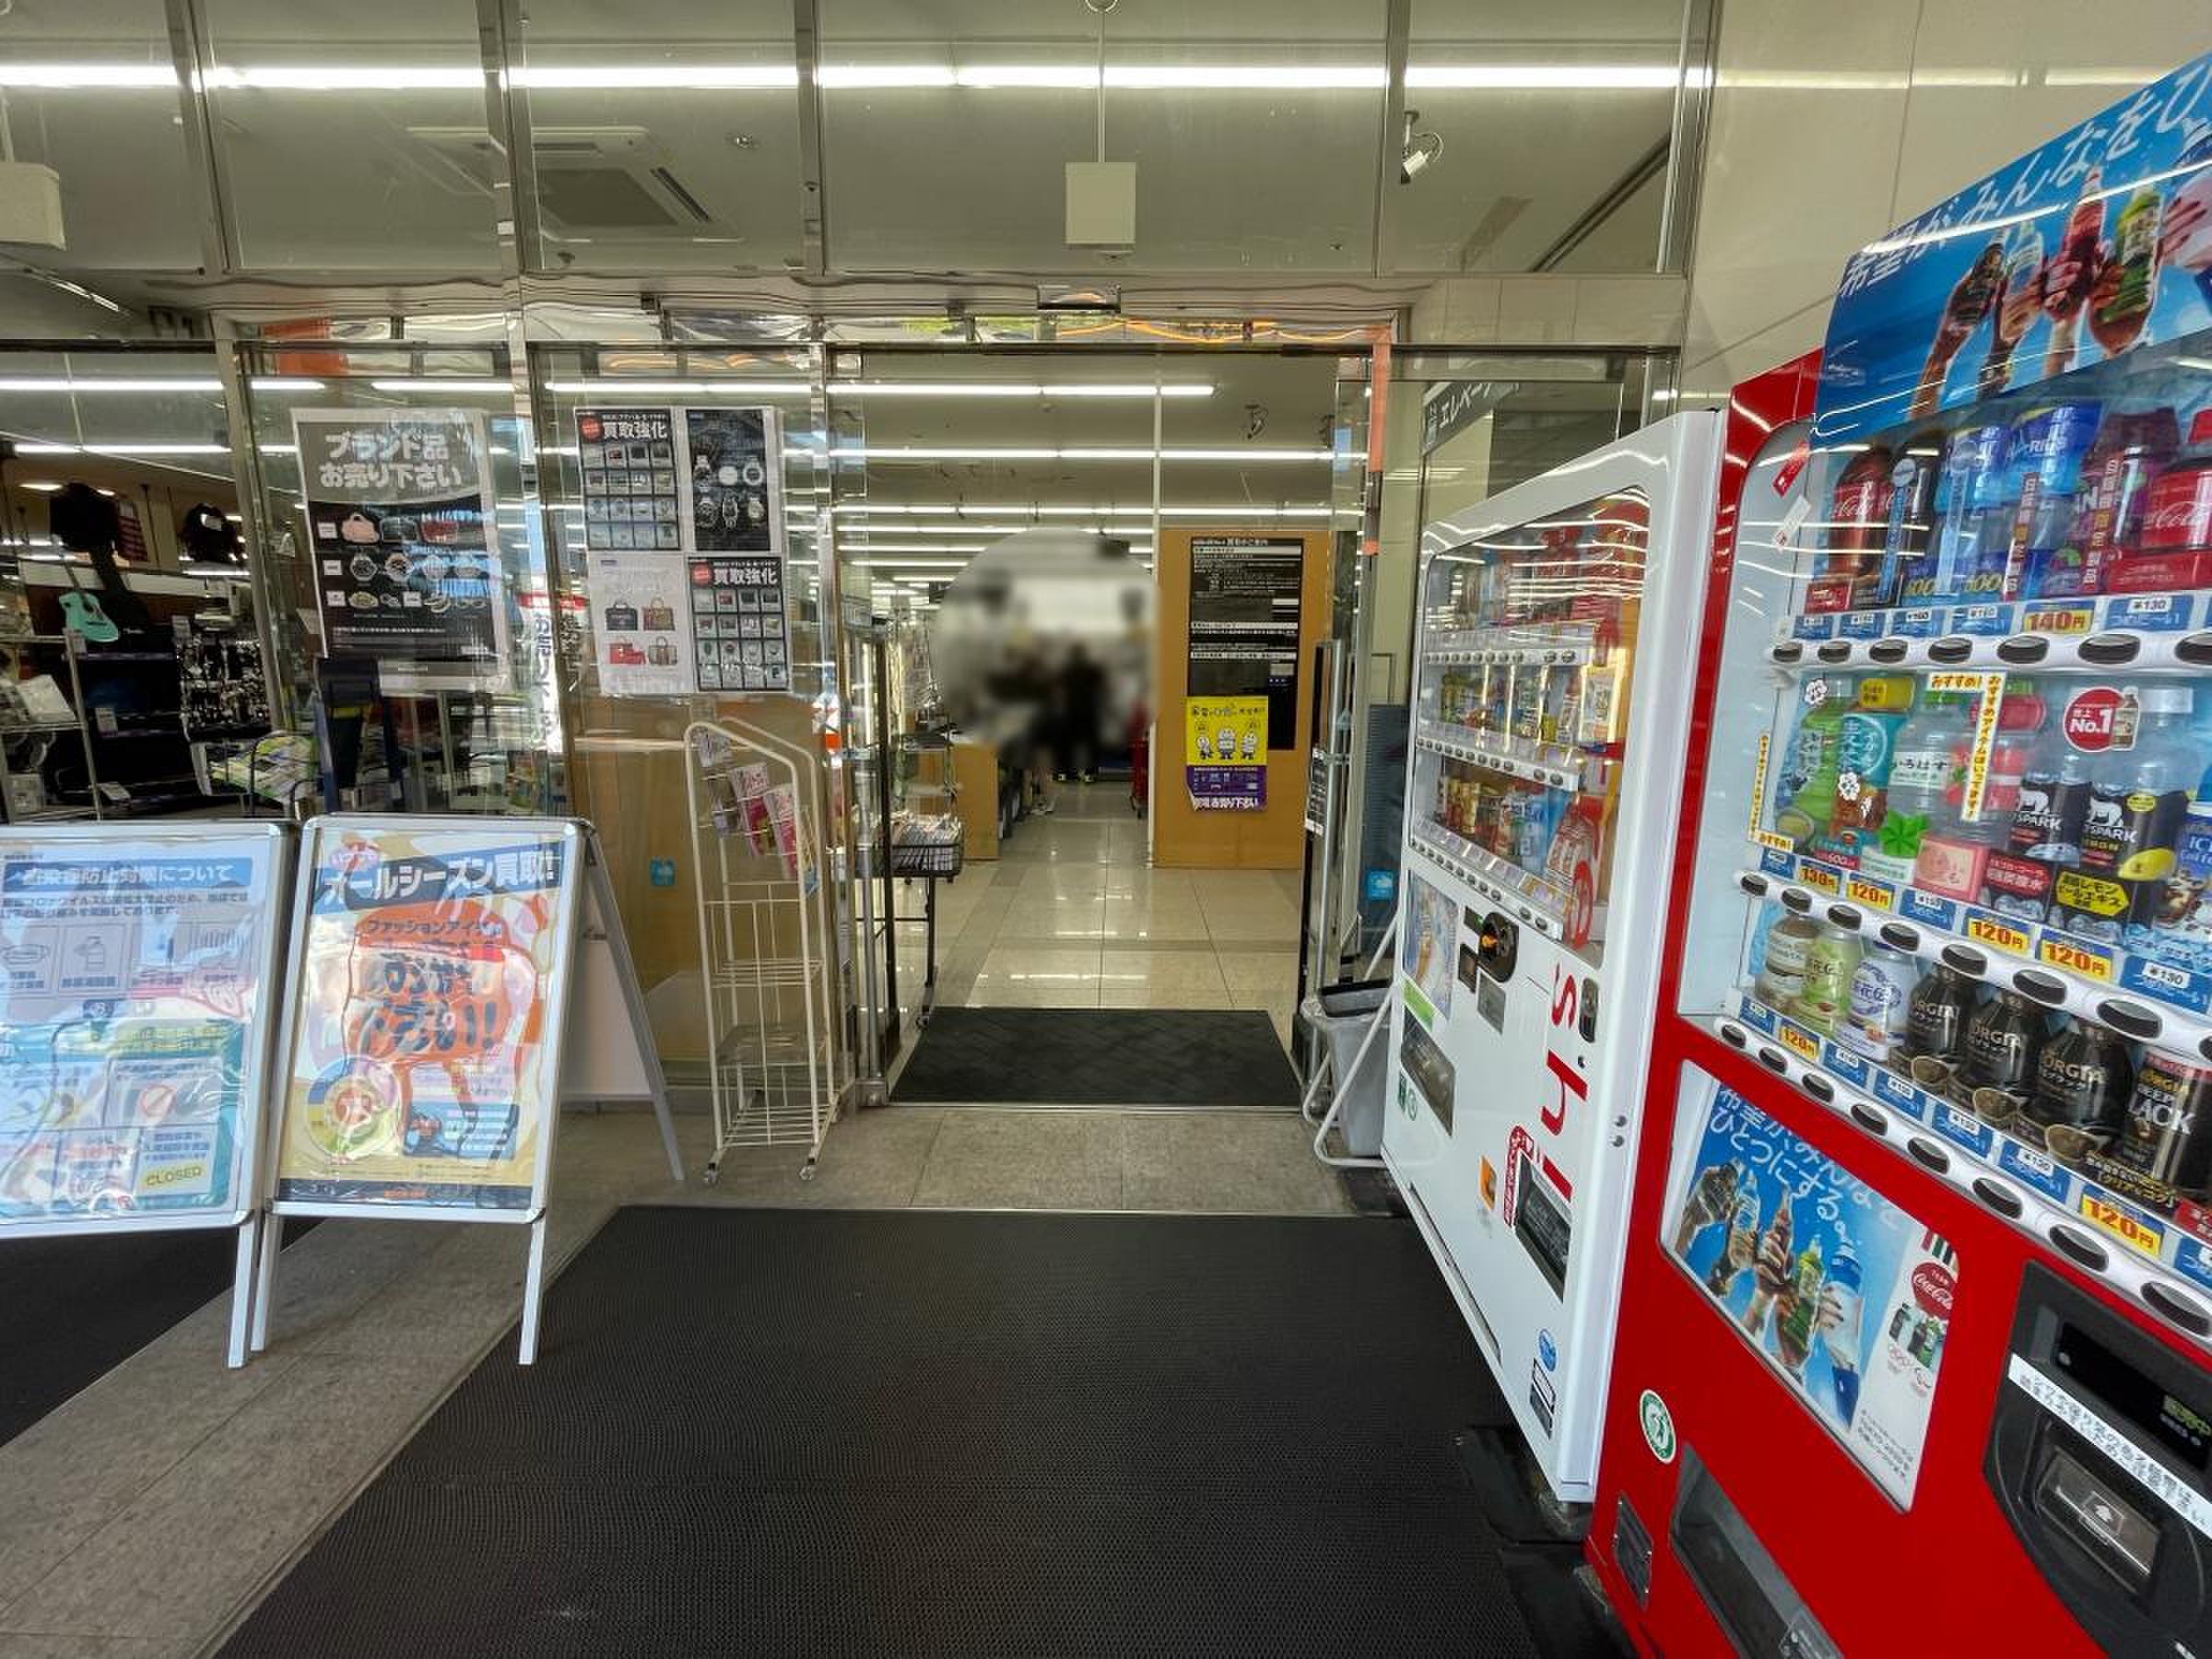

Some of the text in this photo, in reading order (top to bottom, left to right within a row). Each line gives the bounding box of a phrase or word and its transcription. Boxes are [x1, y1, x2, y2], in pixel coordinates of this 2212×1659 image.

[604, 421, 668, 440] 買取強化
[324, 431, 449, 459] ブランド品
[320, 463, 462, 488] お売り下さい
[713, 568, 779, 585] 買取強化
[2029, 613, 2087, 631] 140円
[2069, 708, 2113, 735] No.1
[1853, 882, 1888, 902] 120円
[1974, 922, 2023, 949] 120円
[2045, 944, 2105, 975] 120円
[146, 1165, 205, 1187] CLOSED
[2088, 1200, 2153, 1250] 120円
